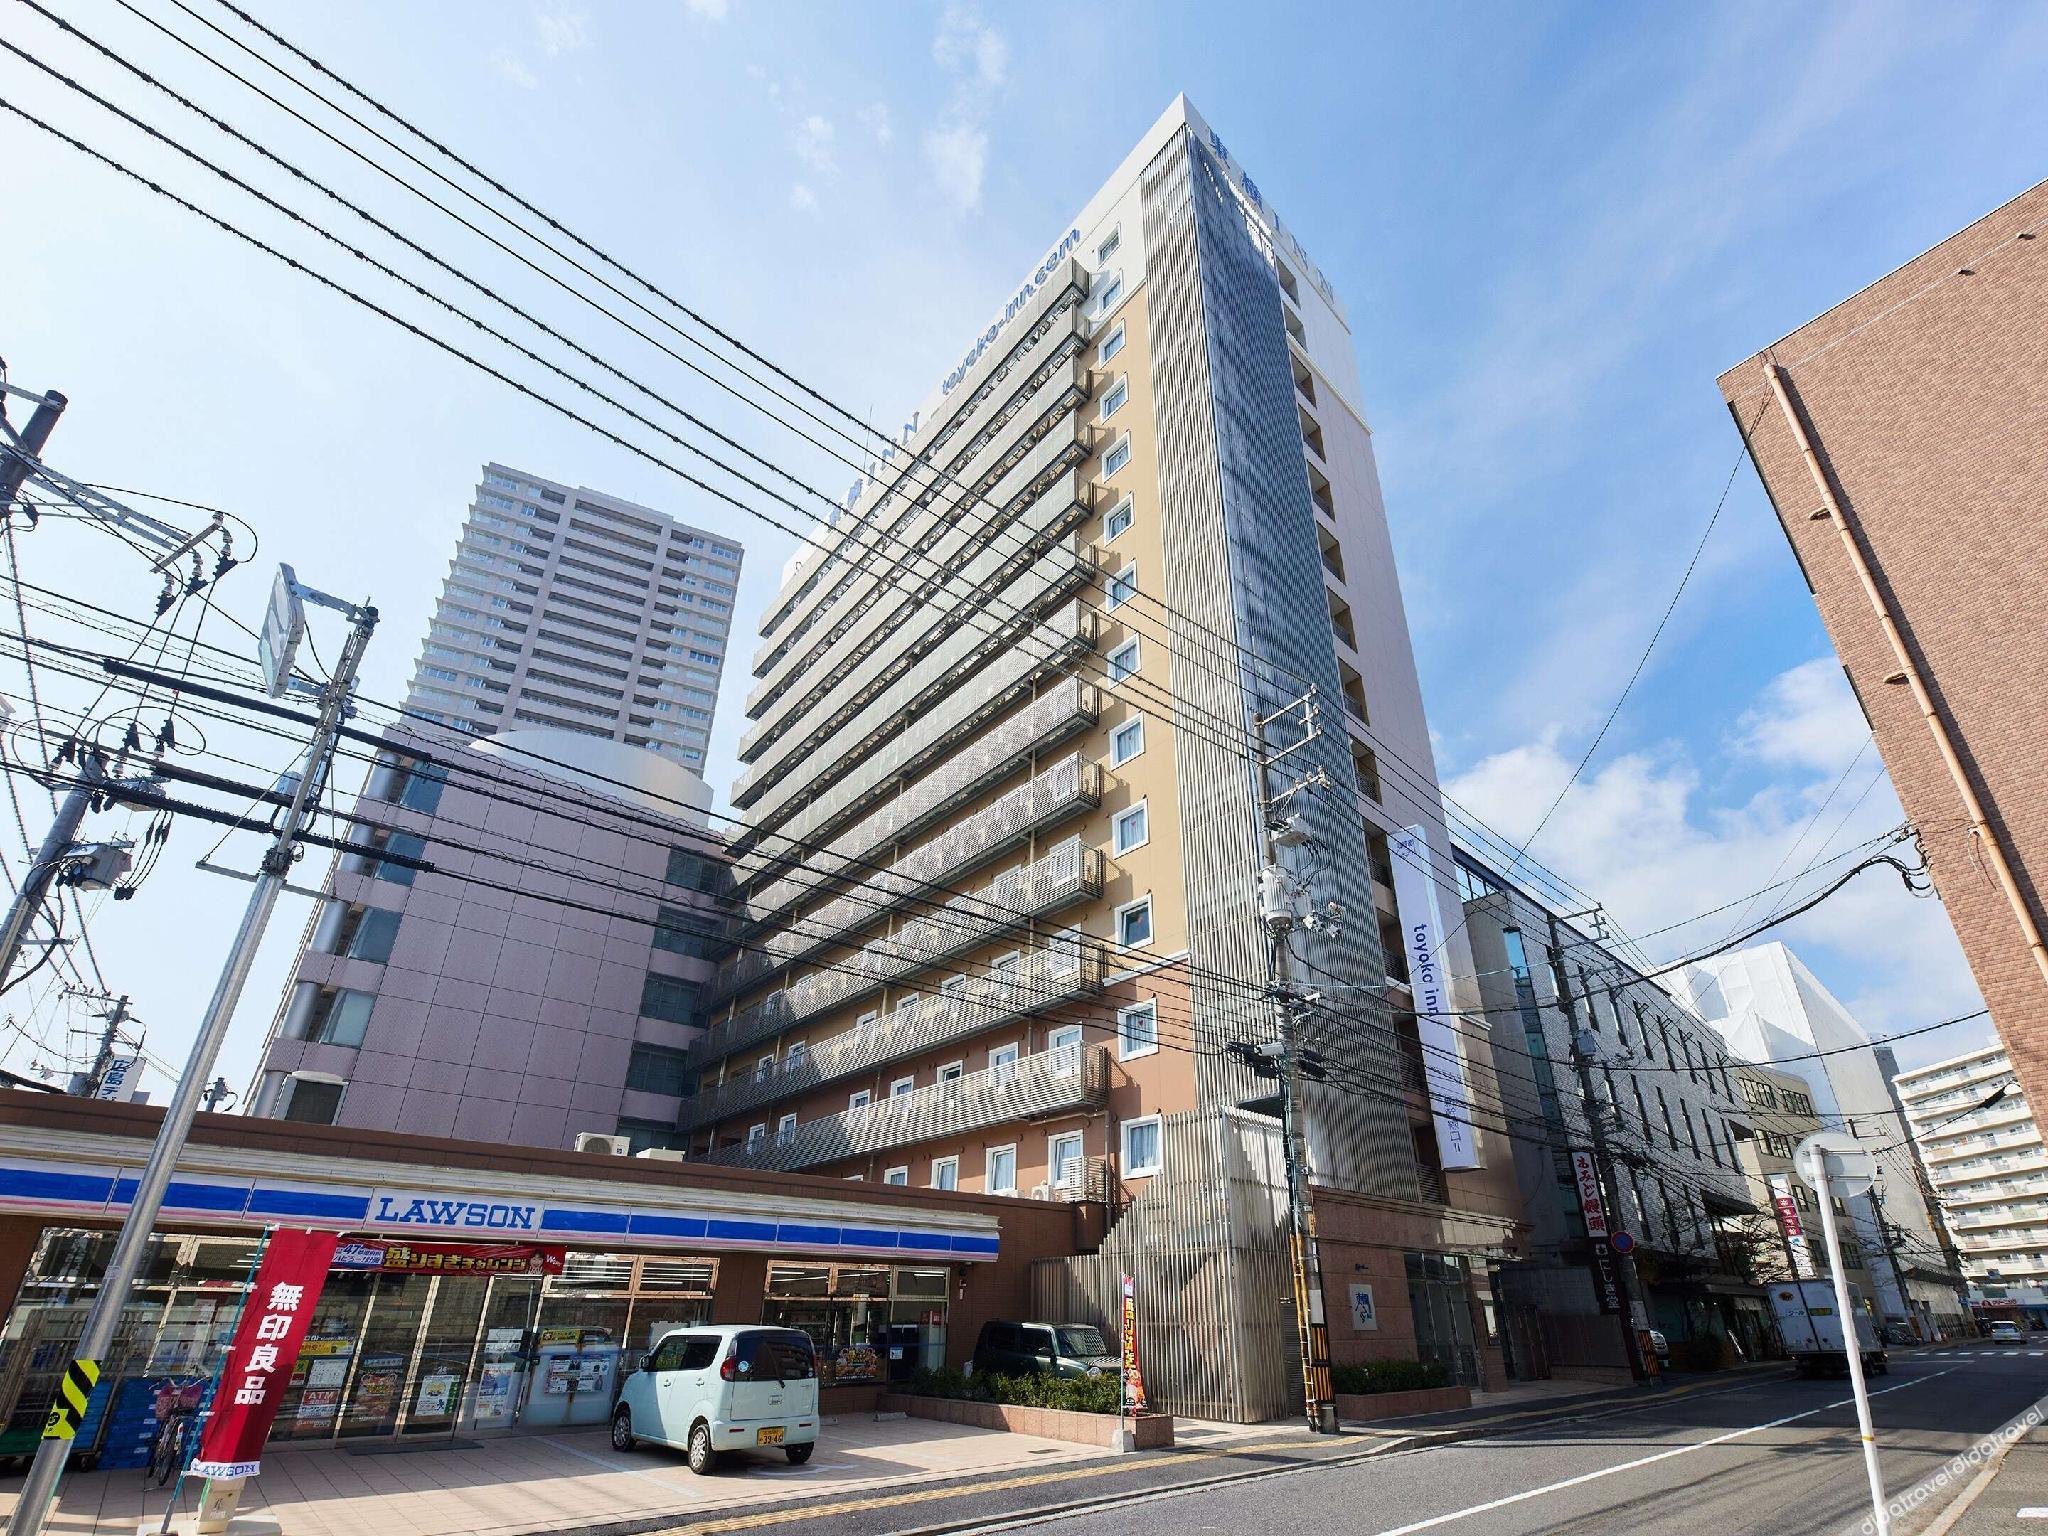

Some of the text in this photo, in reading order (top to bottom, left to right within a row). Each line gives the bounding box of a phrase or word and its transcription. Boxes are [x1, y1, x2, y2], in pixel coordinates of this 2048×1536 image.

[942, 228, 1081, 395] toyoko-inn.com
[1413, 923, 1435, 984] toyoko
[374, 1197, 536, 1230] LAWSON
[1576, 1155, 1606, 1232] もみじ饅頭
[383, 1246, 528, 1271] 盛りすぎチャレンジ
[234, 1281, 304, 1405] 無印良品
[307, 1391, 335, 1401] ATM
[192, 1460, 257, 1478] LAWSON
